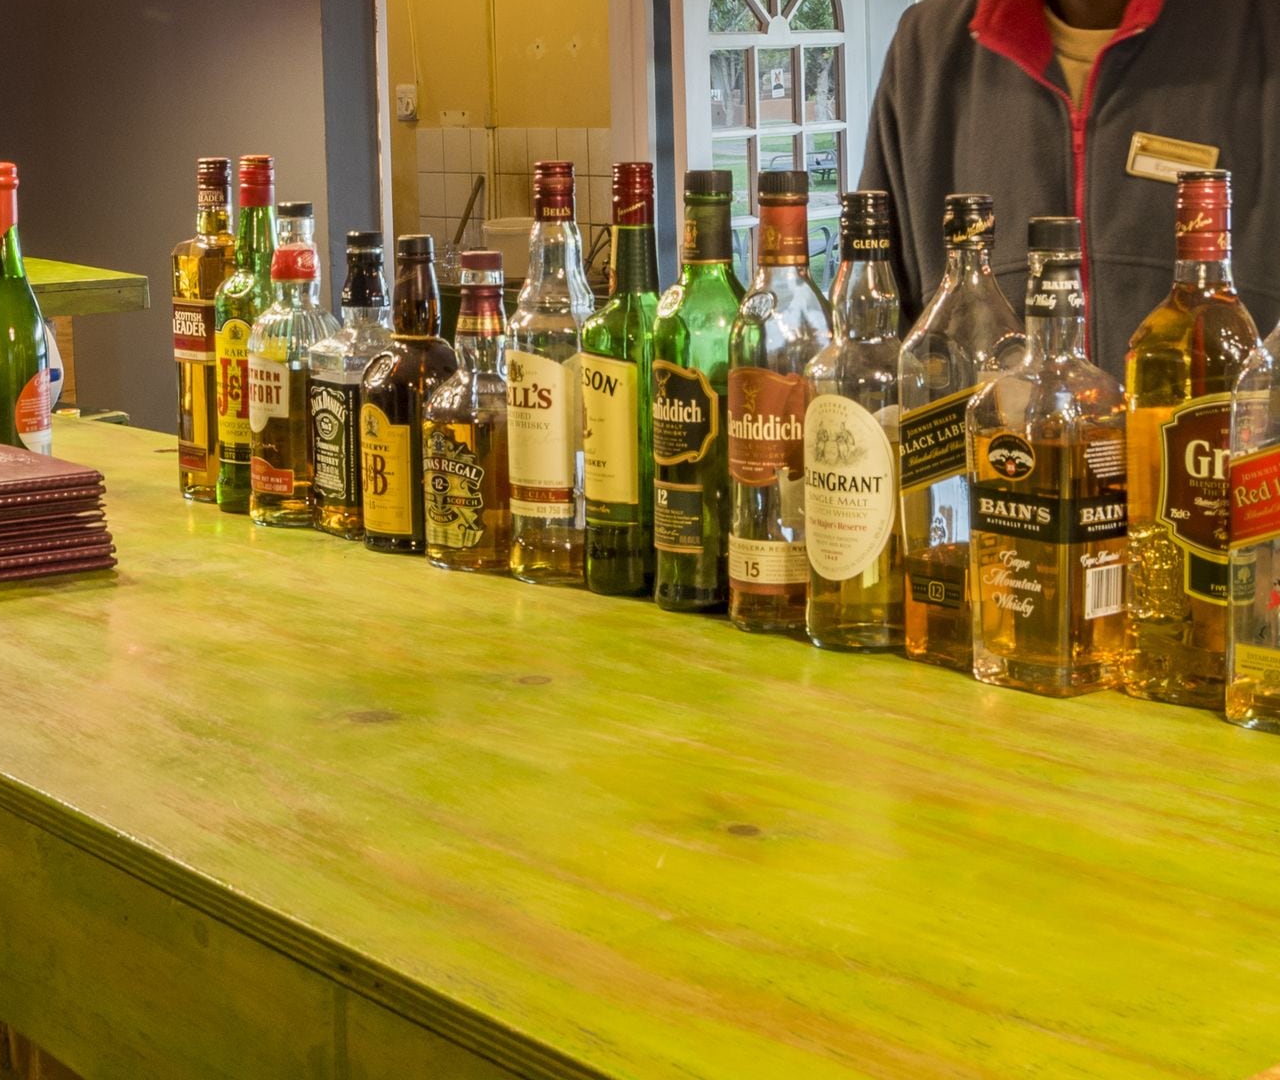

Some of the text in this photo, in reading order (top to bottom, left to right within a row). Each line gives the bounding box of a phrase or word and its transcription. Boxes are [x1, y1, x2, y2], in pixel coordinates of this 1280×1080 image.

[543, 206, 570, 217] BELL'S
[853, 239, 878, 250] GLEN
[174, 311, 202, 321] SCOTTISH
[172, 320, 207, 337] LEADER
[322, 390, 349, 424] DANIEL'S
[907, 413, 957, 438] JOHNNIE WALKER
[899, 433, 935, 457] BLACK
[441, 459, 479, 480] REGAL
[1241, 466, 1278, 483] JOHNNIE
[435, 478, 443, 489] 12
[446, 497, 477, 506] SCOTCH
[657, 489, 668, 505] 12
[837, 497, 868, 507] MALT
[1234, 480, 1272, 508] Red
[833, 510, 867, 518] WHISKY
[979, 497, 1051, 523] BAIN'S
[838, 520, 867, 532] Reserve
[987, 518, 1040, 532] NATURALLY PURE
[744, 560, 760, 578] 15
[999, 550, 1031, 571] Cape
[984, 568, 1042, 593] Mountain
[932, 585, 942, 597] 12
[992, 592, 1034, 617] Whisky
